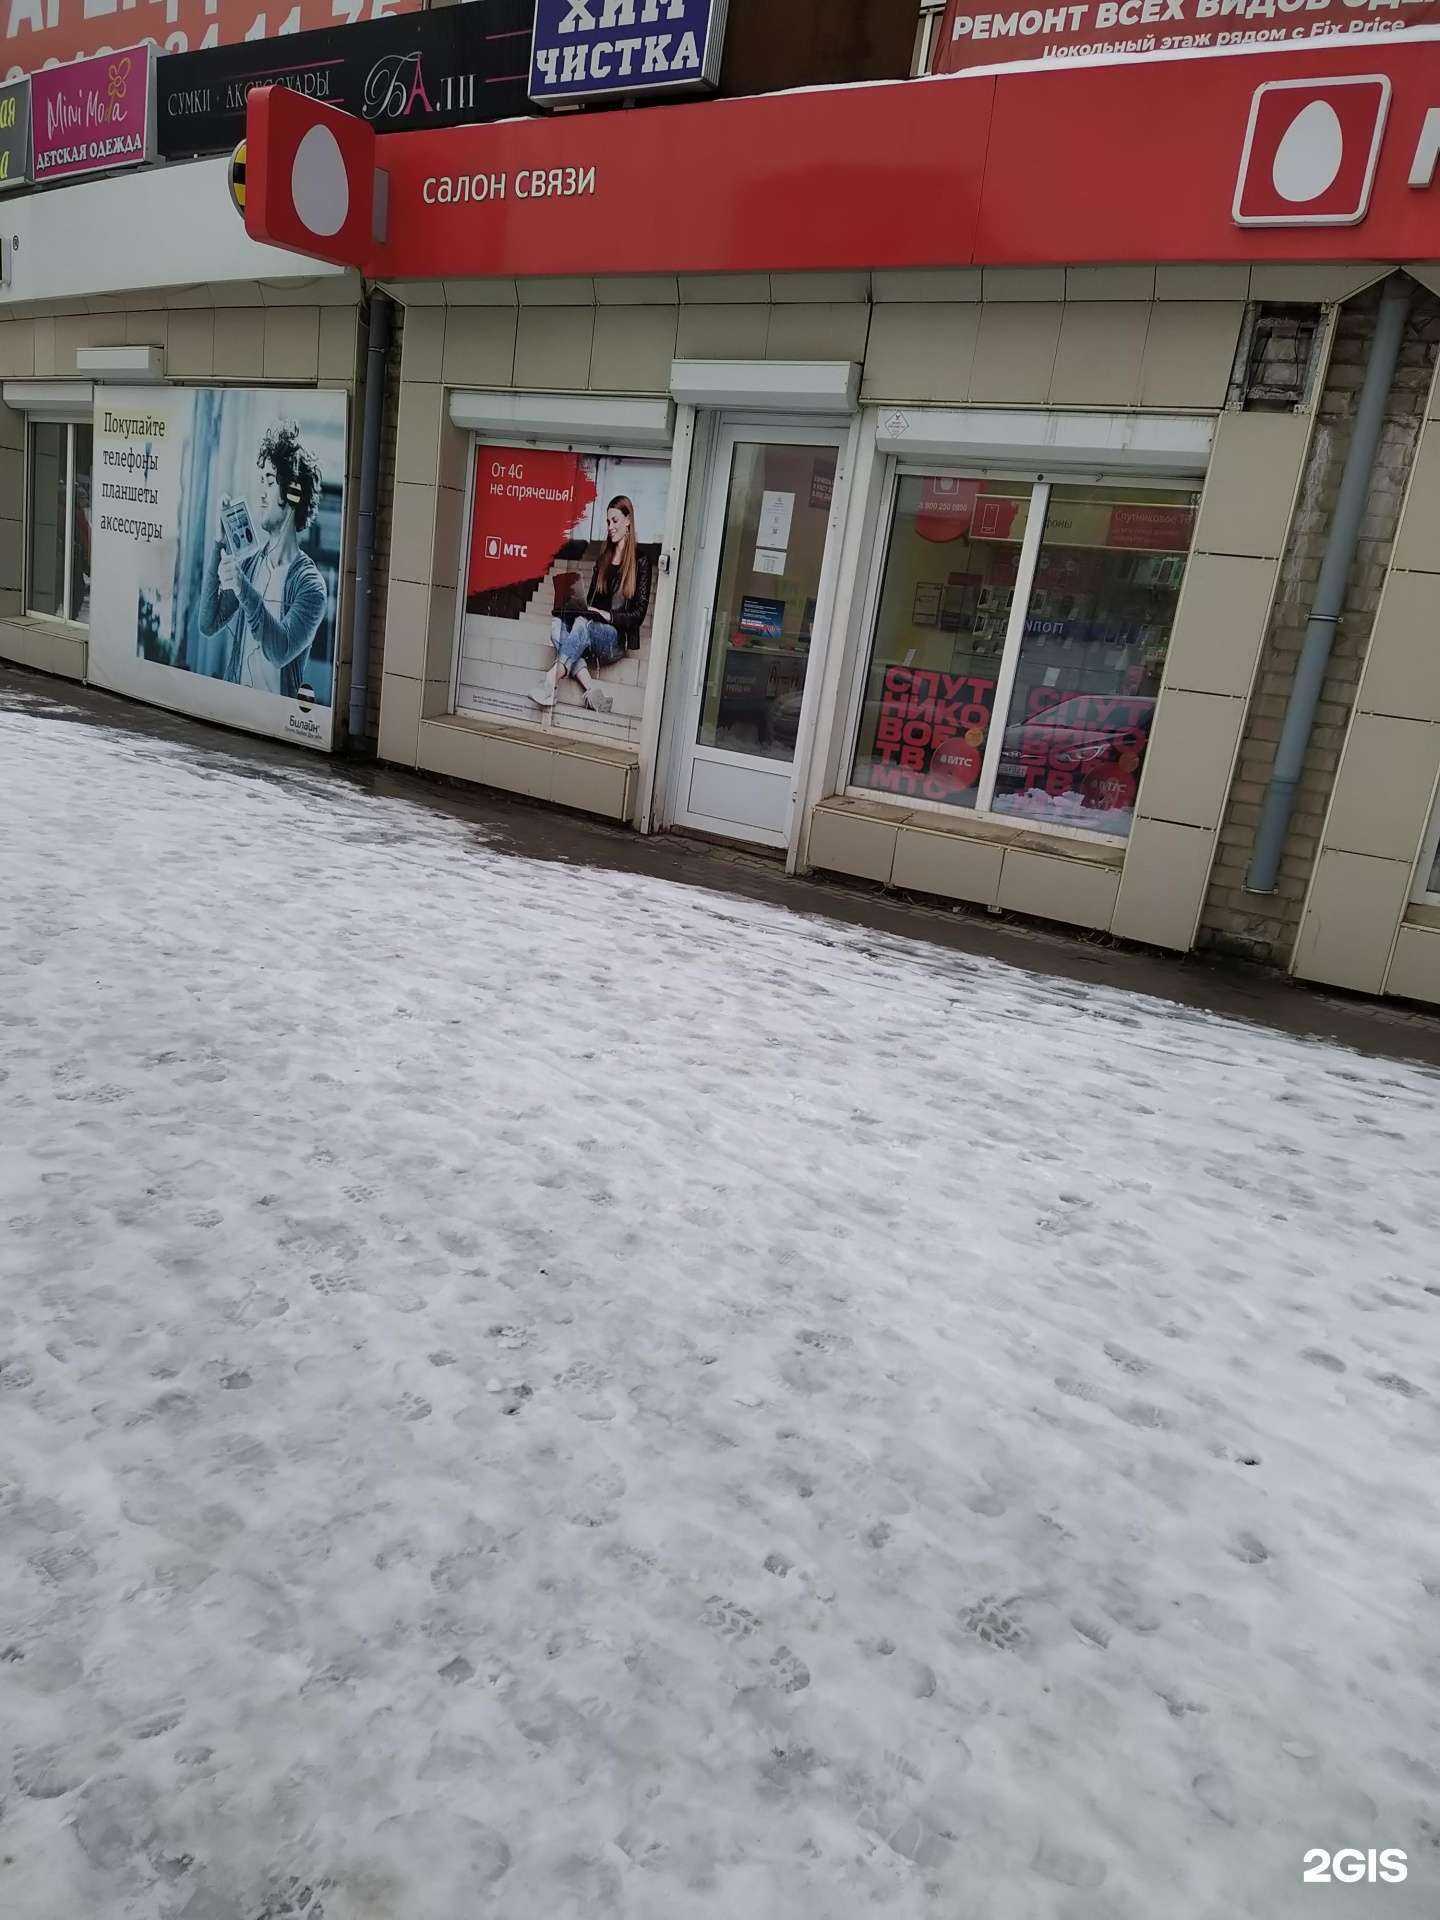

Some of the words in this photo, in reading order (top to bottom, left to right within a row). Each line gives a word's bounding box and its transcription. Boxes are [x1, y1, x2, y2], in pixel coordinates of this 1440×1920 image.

[952, 5, 1088, 41] РЕМОНТ
[1095, 0, 1184, 29] ВСЕХ
[1043, 35, 1155, 58] Цокольный
[1160, 31, 1210, 49] этаж
[1216, 27, 1285, 48] рядом
[1291, 27, 1304, 39] с
[1309, 20, 1343, 37] Fix
[1349, 17, 1405, 34] Price
[537, 31, 700, 84] ЧИСТКА
[47, 89, 82, 140] Mini
[86, 89, 128, 127] Moda
[168, 88, 211, 117] СУМКИ
[37, 144, 87, 170] ДЕТСКАЯ
[90, 133, 142, 159] ОДЕЖДА
[423, 173, 507, 204] салон
[514, 166, 598, 198] связи
[104, 412, 166, 440] Покупайте
[103, 447, 159, 473] телефоны
[491, 462, 506, 478] От
[508, 463, 524, 480] 4G
[102, 481, 158, 506] планшеты
[490, 483, 504, 496] не
[100, 516, 162, 543] аксессуары
[503, 543, 528, 559] МТС
[886, 667, 994, 704] СПУТ
[882, 691, 991, 731] НИКО
[875, 740, 926, 773] ТВ
[947, 755, 973, 767] МТС
[869, 763, 950, 800] МТС
